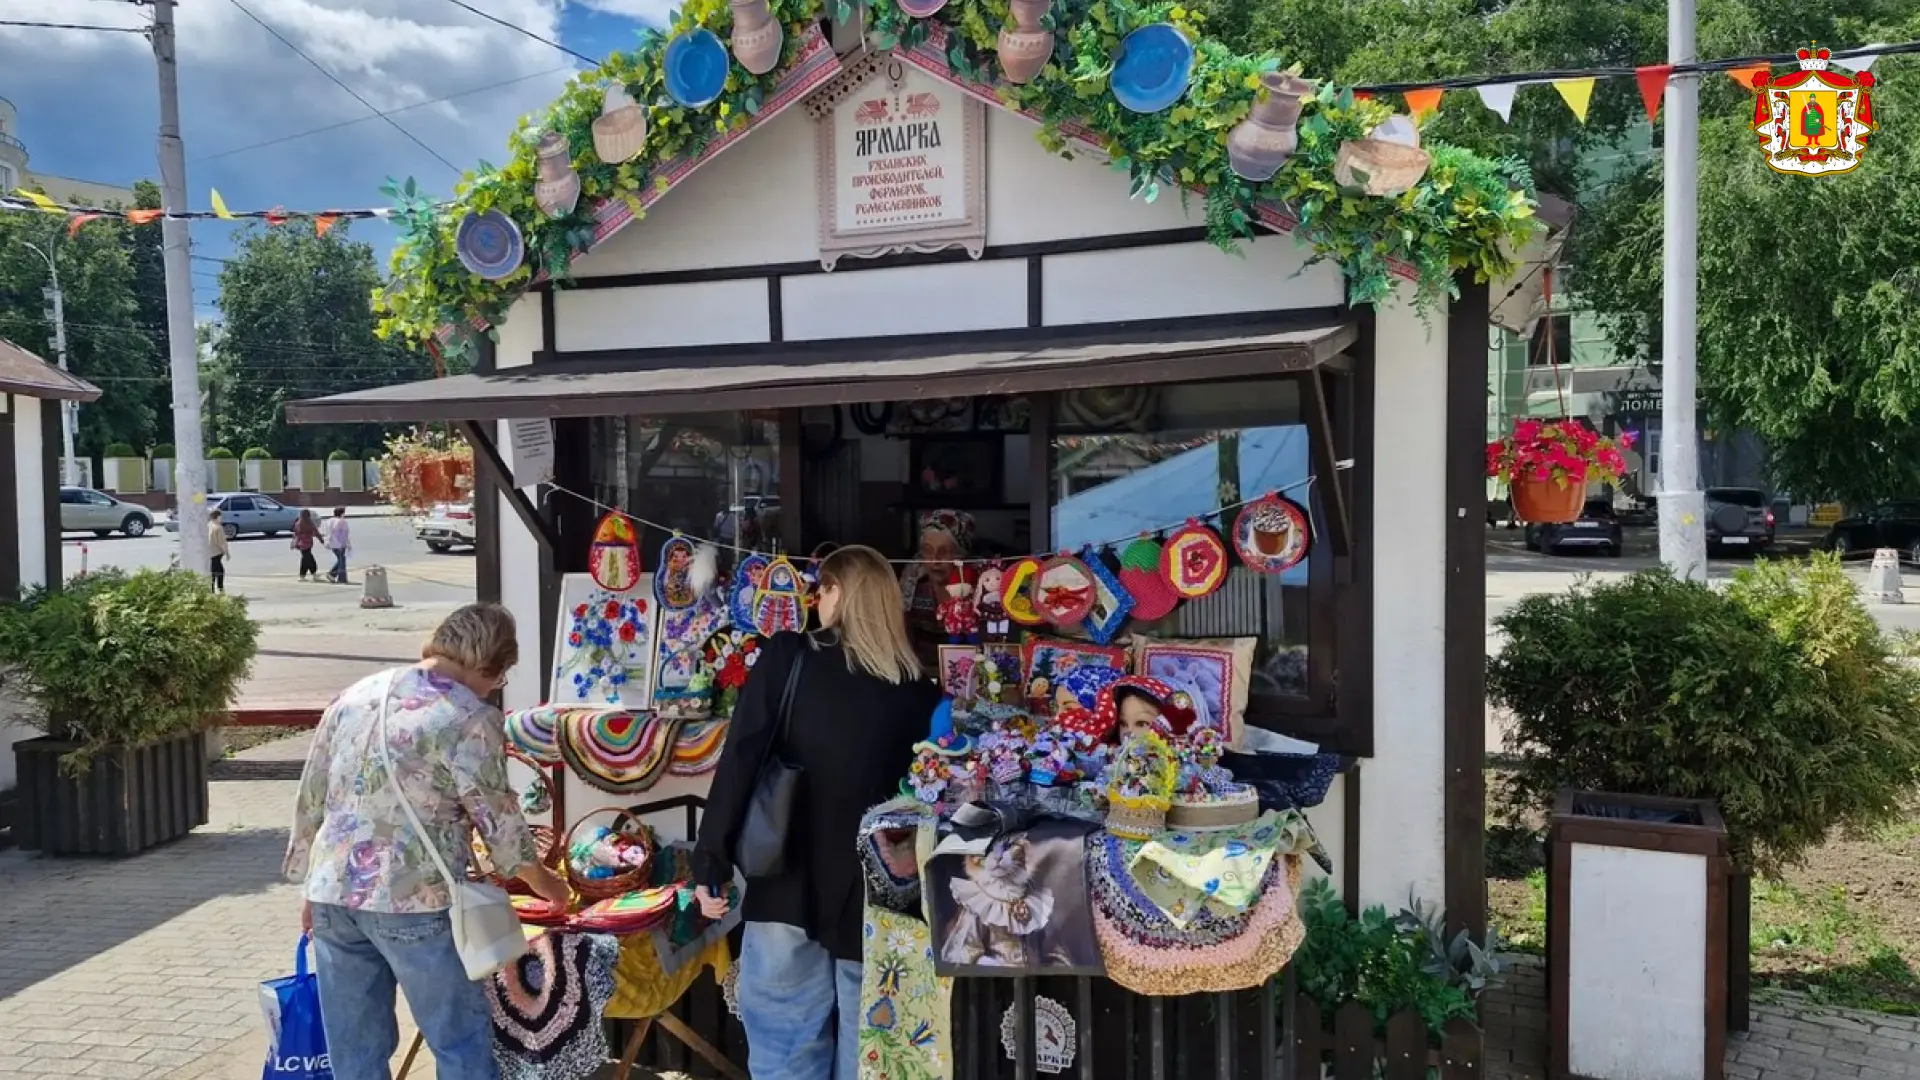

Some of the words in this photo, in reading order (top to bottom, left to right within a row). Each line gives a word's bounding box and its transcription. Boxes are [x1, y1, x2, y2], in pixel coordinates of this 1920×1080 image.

[855, 121, 942, 157] ЯРМАРКА
[868, 154, 927, 173] РЯЗАНСКИХ
[855, 195, 943, 215] РЕМЕСЛЕННИКОВ
[274, 1056, 300, 1071] LC
